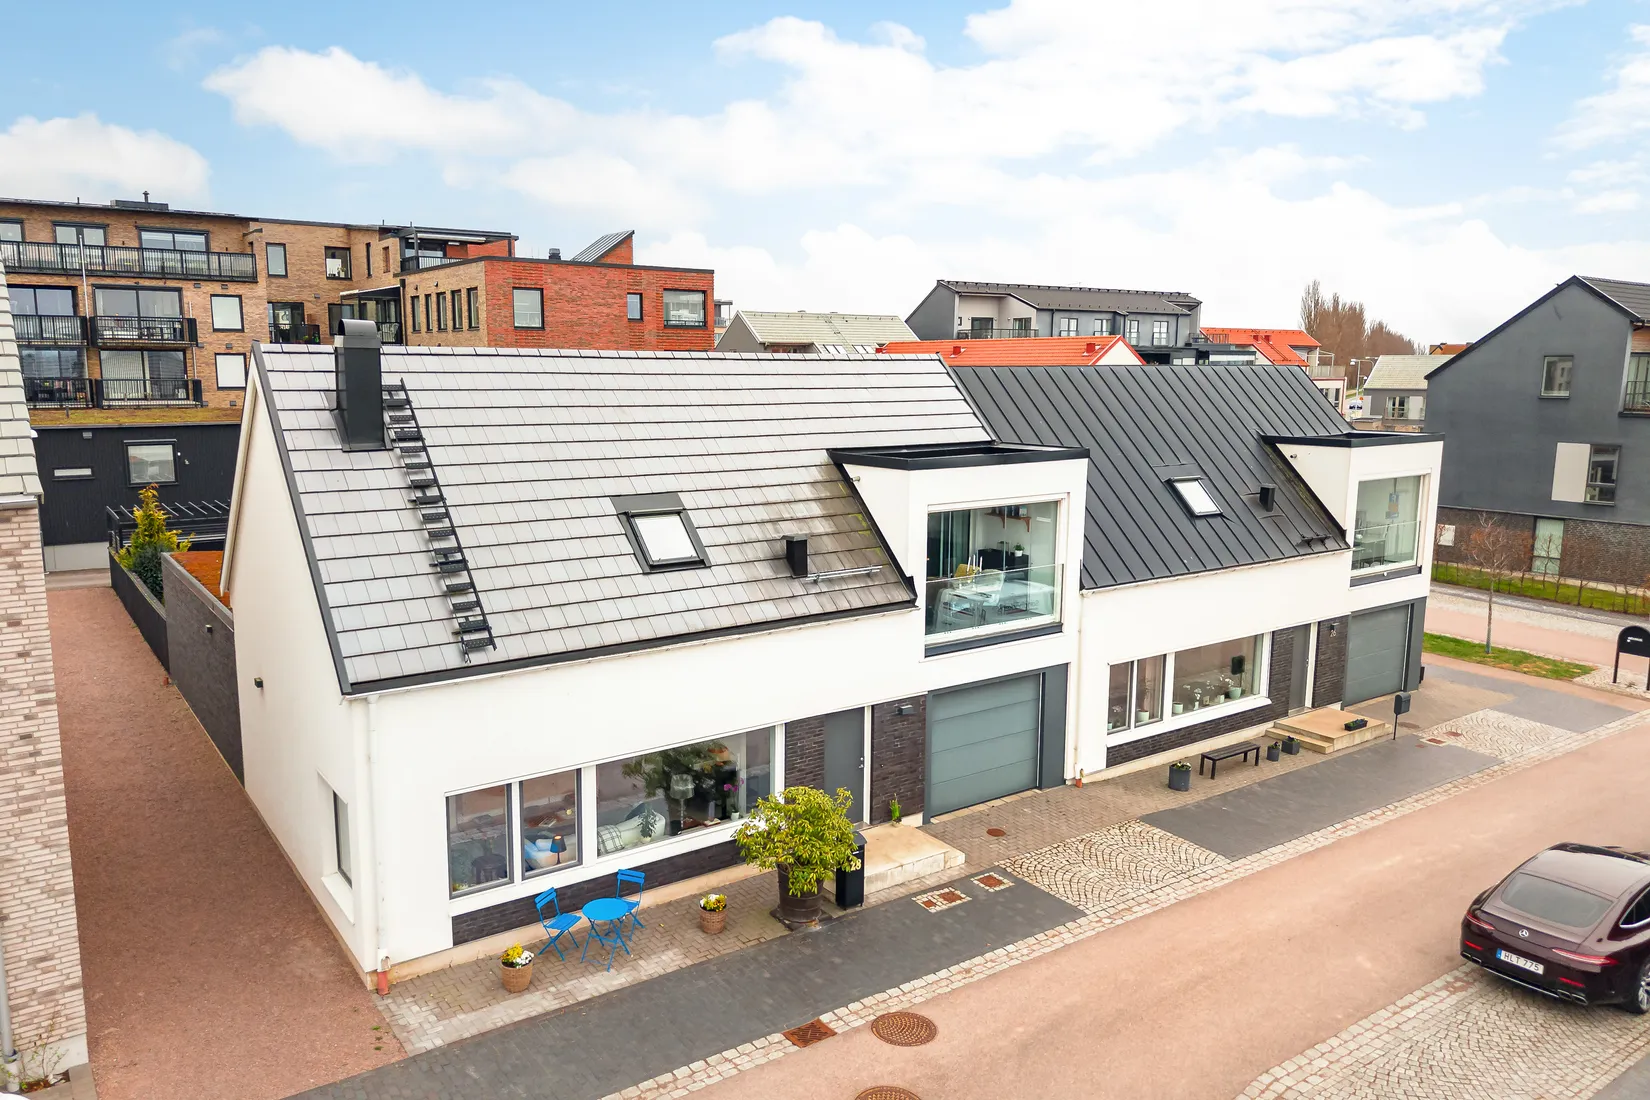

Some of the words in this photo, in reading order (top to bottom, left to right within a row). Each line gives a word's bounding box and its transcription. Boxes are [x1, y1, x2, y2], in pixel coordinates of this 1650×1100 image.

[850, 859, 862, 871] 28
[1503, 952, 1521, 964] HLT
[1523, 959, 1540, 971] 775
